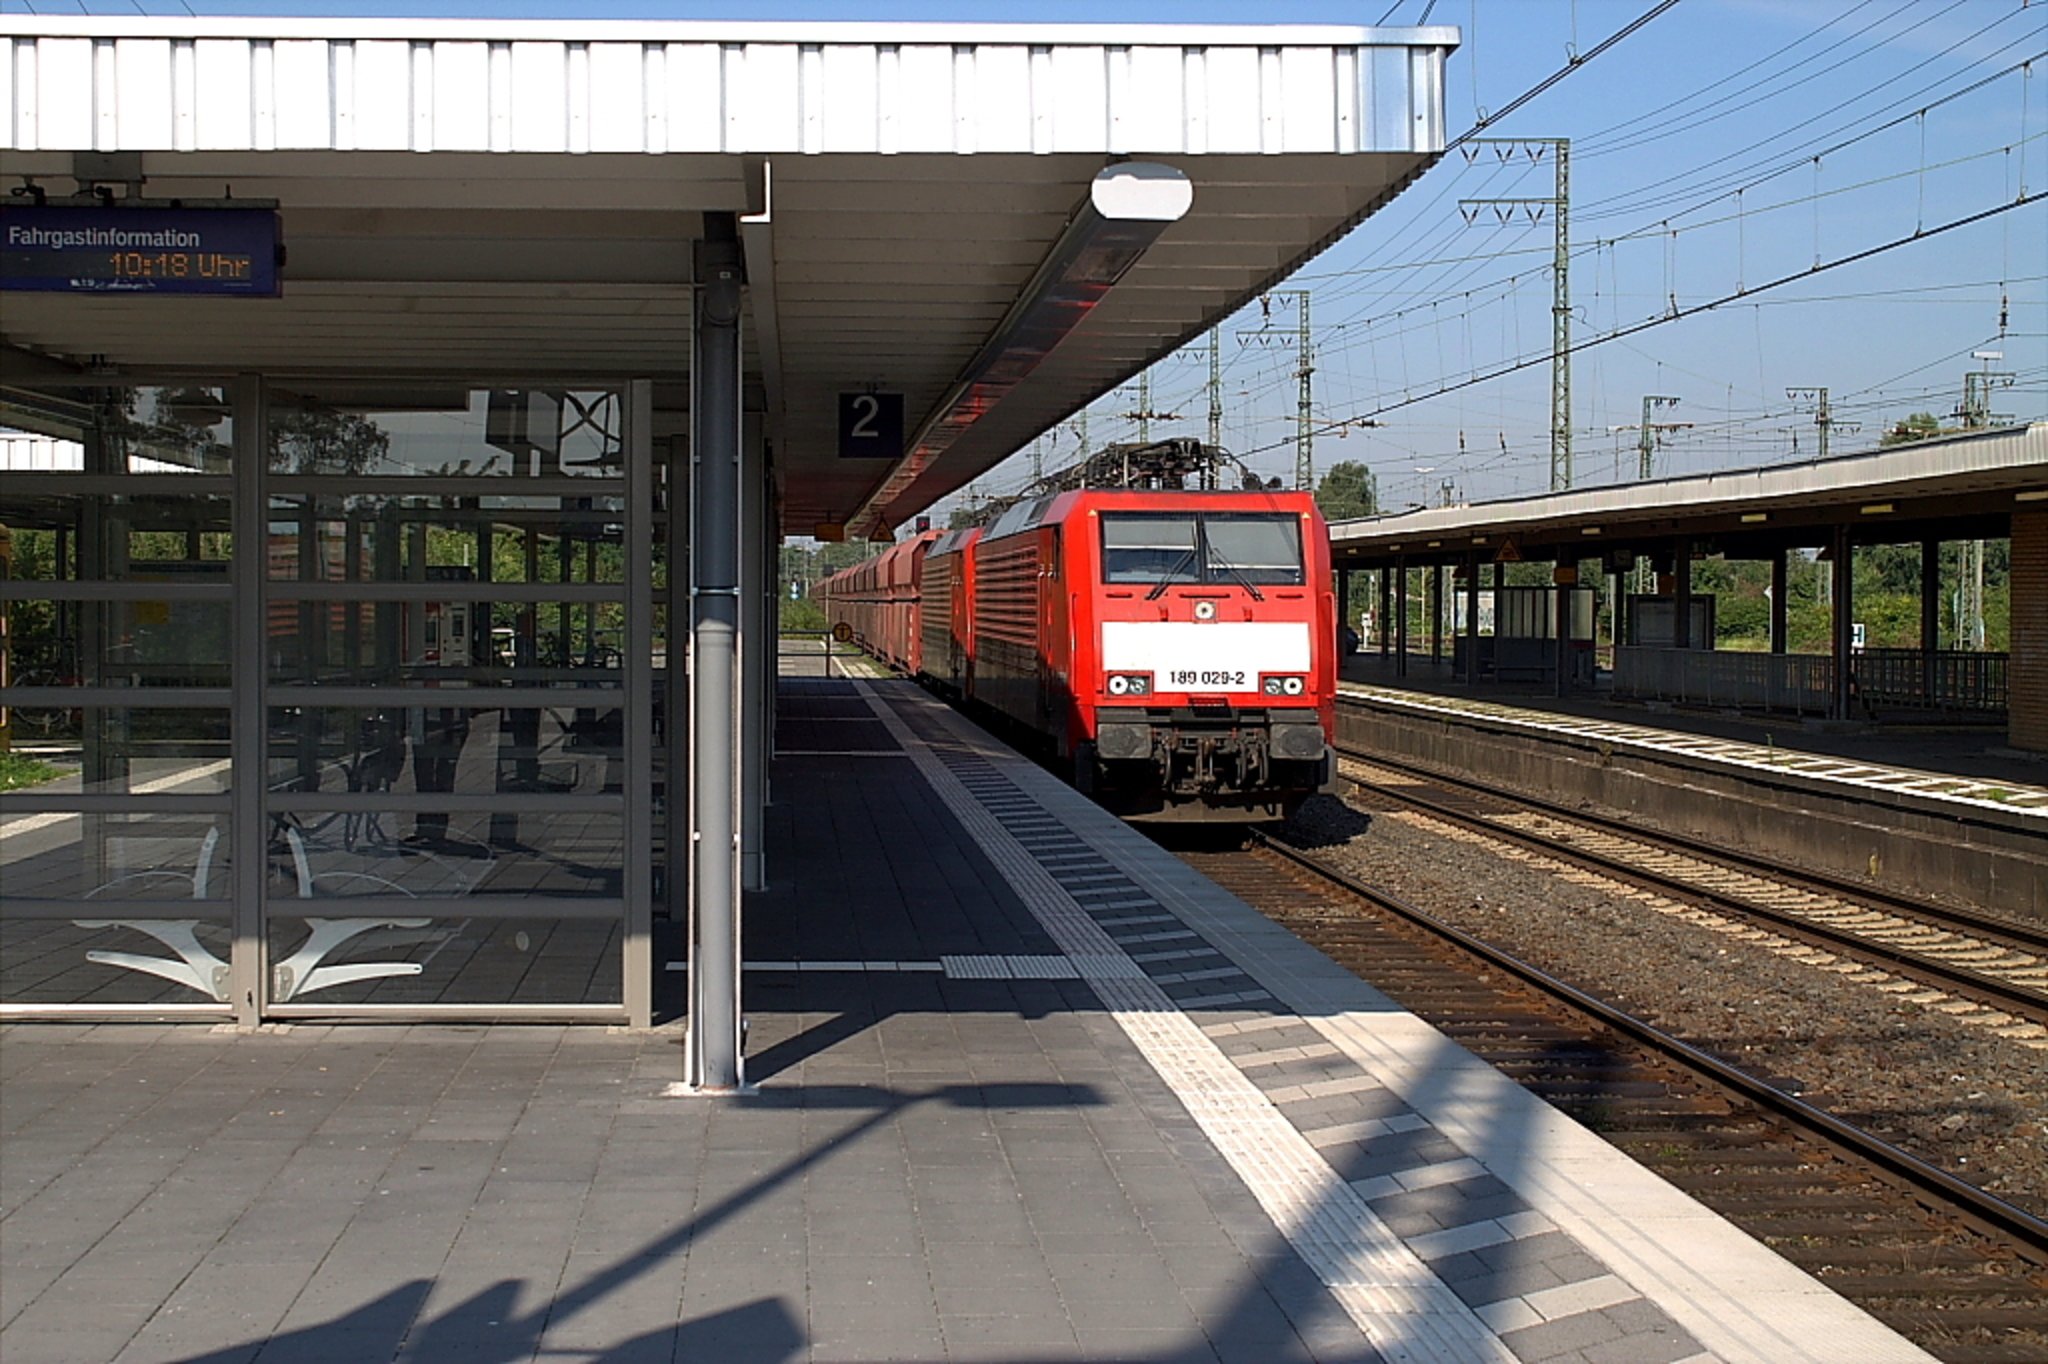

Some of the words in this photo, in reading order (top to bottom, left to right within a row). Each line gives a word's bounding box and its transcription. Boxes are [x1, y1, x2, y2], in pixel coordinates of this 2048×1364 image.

[8, 225, 200, 249] Fahrgastinformation
[109, 252, 189, 277] 10:18
[198, 252, 249, 277] Uhr
[851, 395, 879, 437] 2
[1170, 670, 1197, 685] 189
[1201, 671, 1245, 685] 029-2
